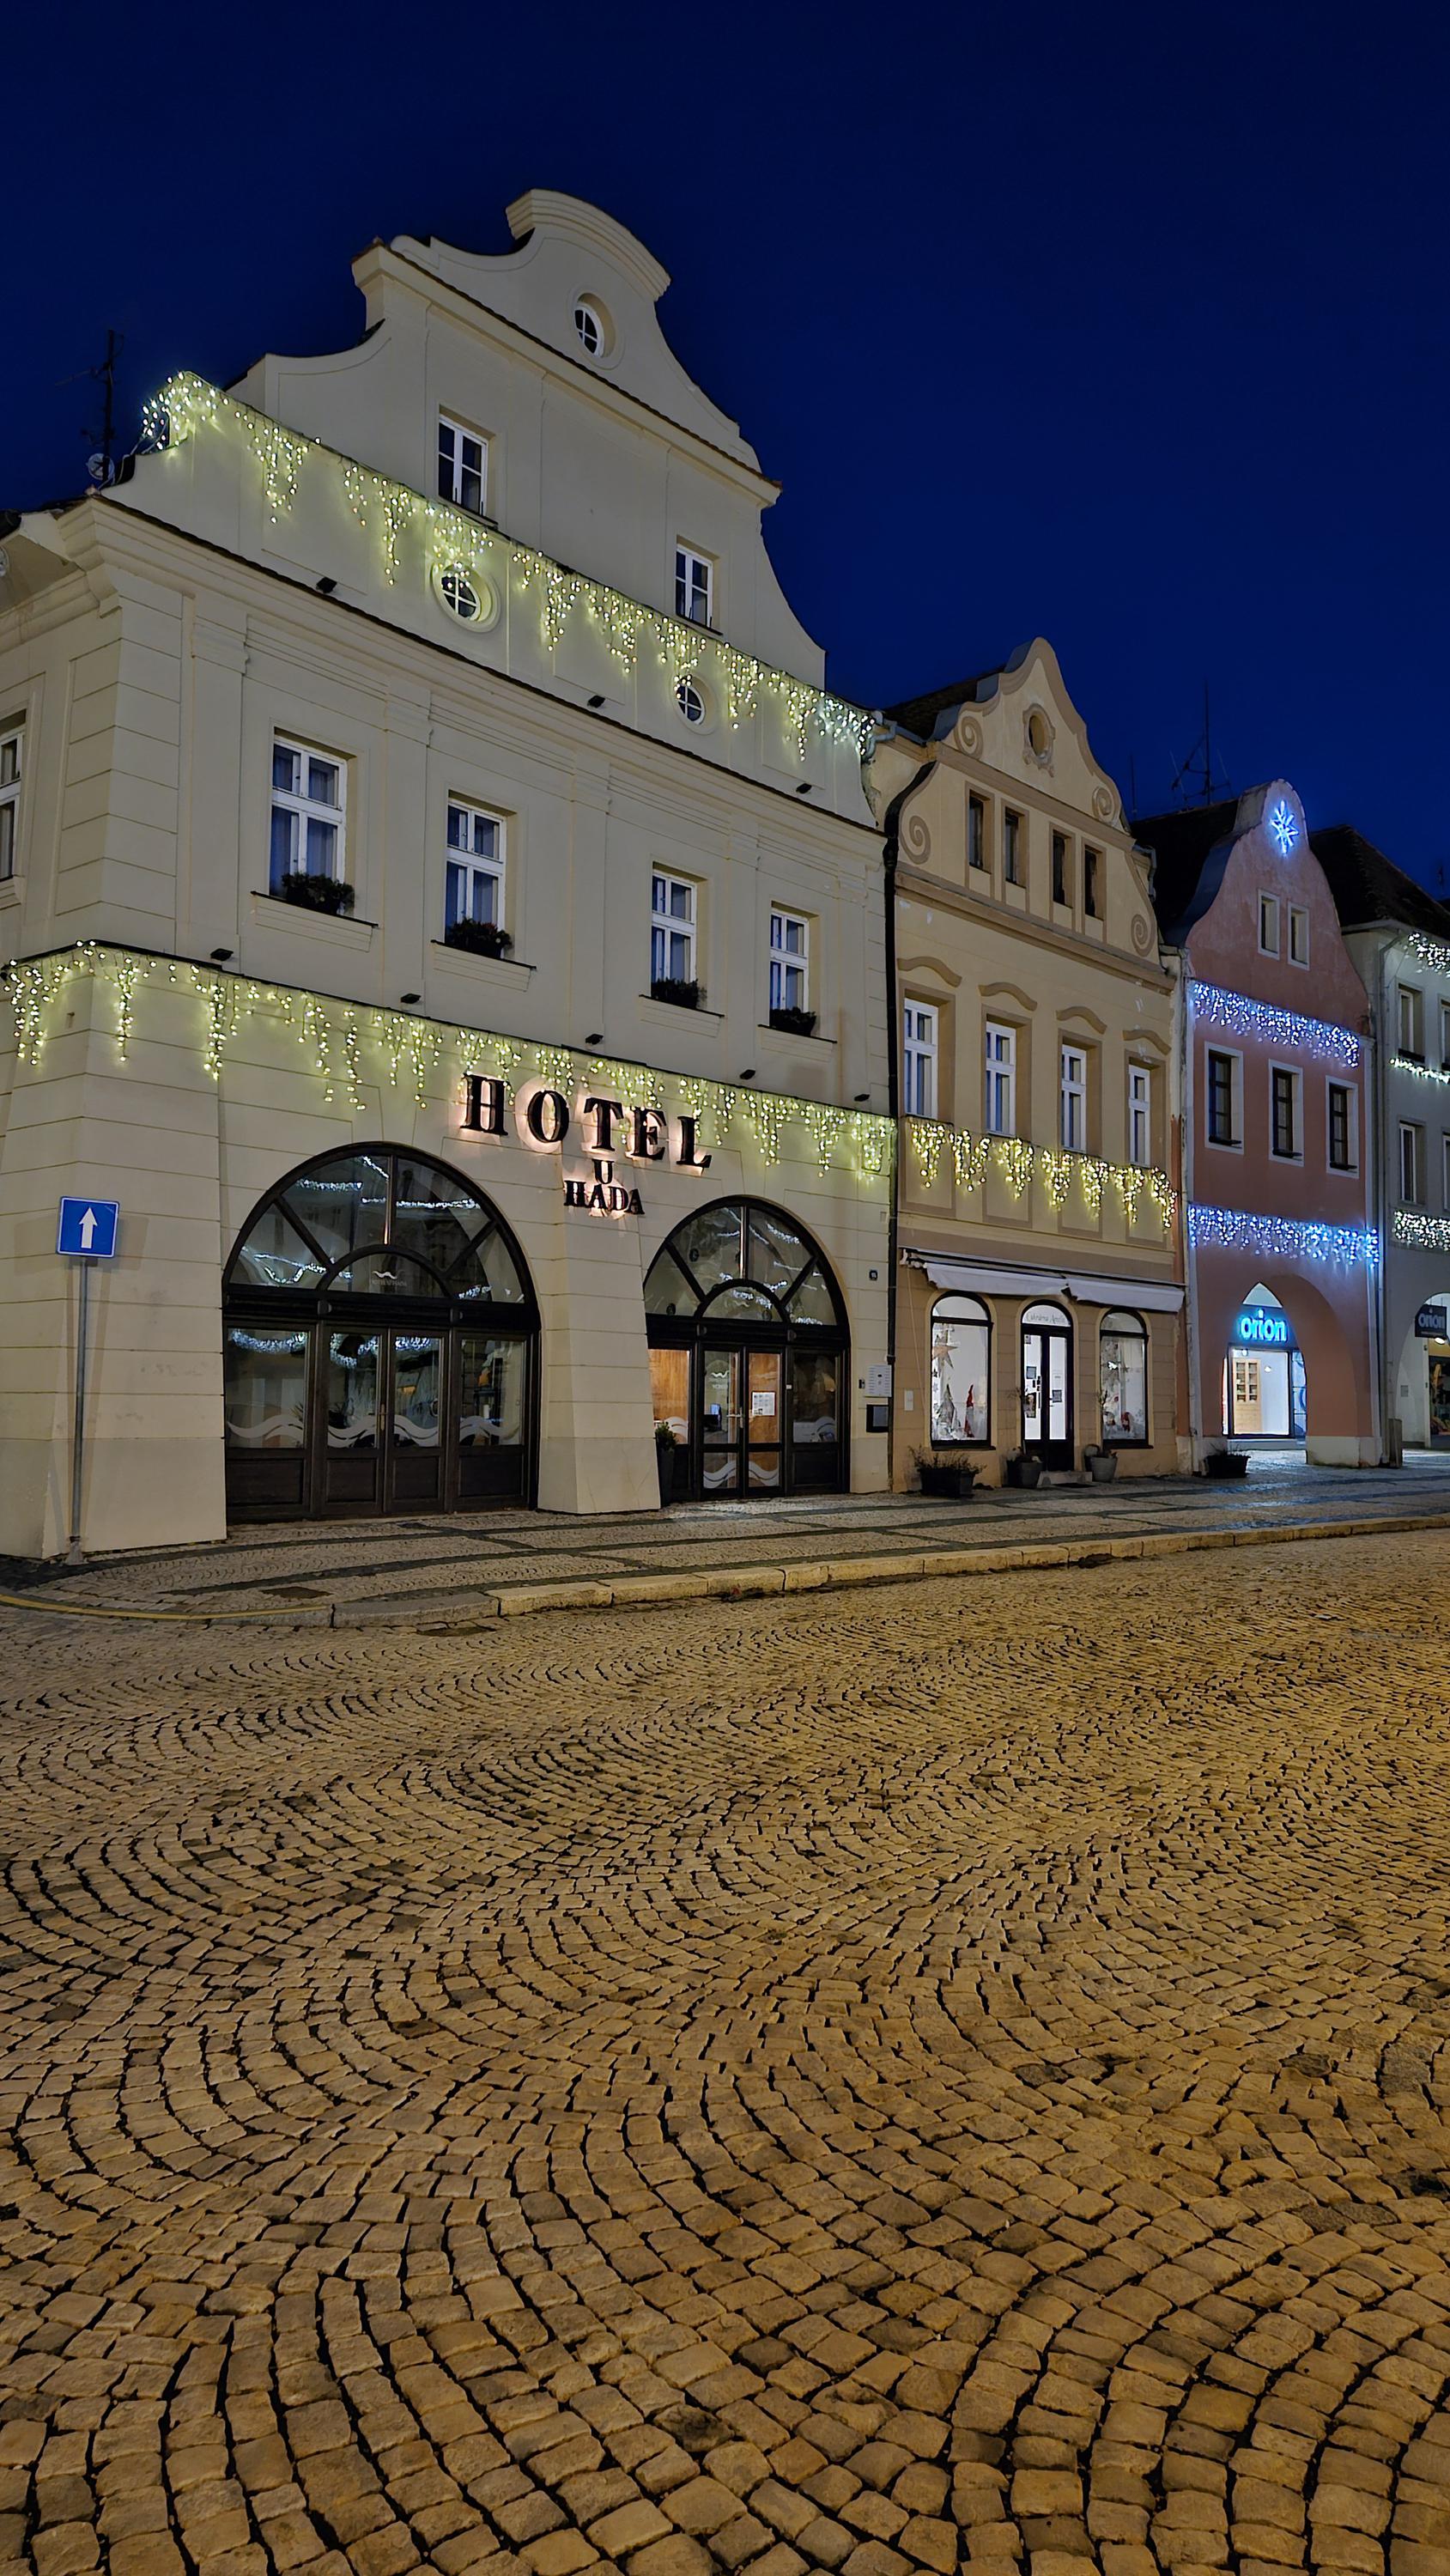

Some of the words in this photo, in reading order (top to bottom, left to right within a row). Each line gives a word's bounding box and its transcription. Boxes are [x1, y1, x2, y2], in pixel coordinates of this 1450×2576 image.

[460, 1073, 712, 1169] HOTEL
[592, 1158, 615, 1185] U
[563, 1180, 646, 1215] HADA
[1241, 1309, 1287, 1341] orion
[1417, 1307, 1446, 1329] orion
